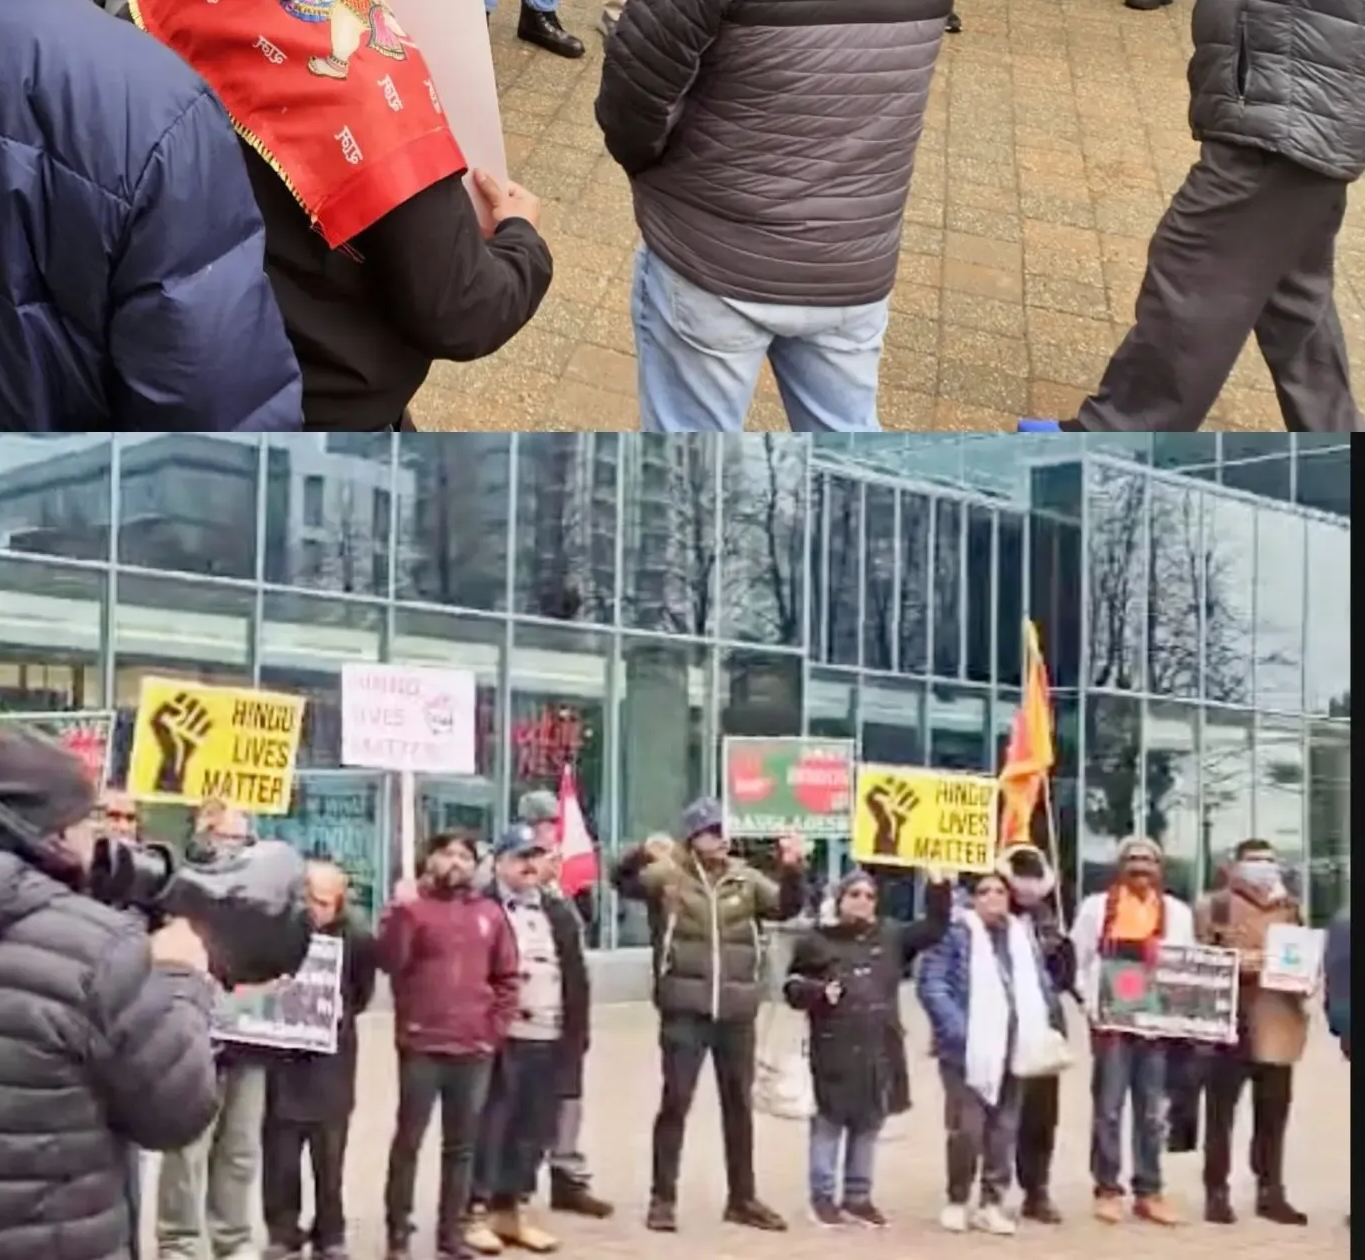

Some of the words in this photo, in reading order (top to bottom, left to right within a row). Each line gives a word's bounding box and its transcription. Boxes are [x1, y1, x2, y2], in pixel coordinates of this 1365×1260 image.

[232, 700, 295, 733] HINDU
[232, 736, 288, 768] LIVES
[201, 769, 282, 805] MATTER
[936, 780, 992, 807] HINDU
[938, 812, 990, 836] LIVES
[914, 841, 986, 864] MATTER
